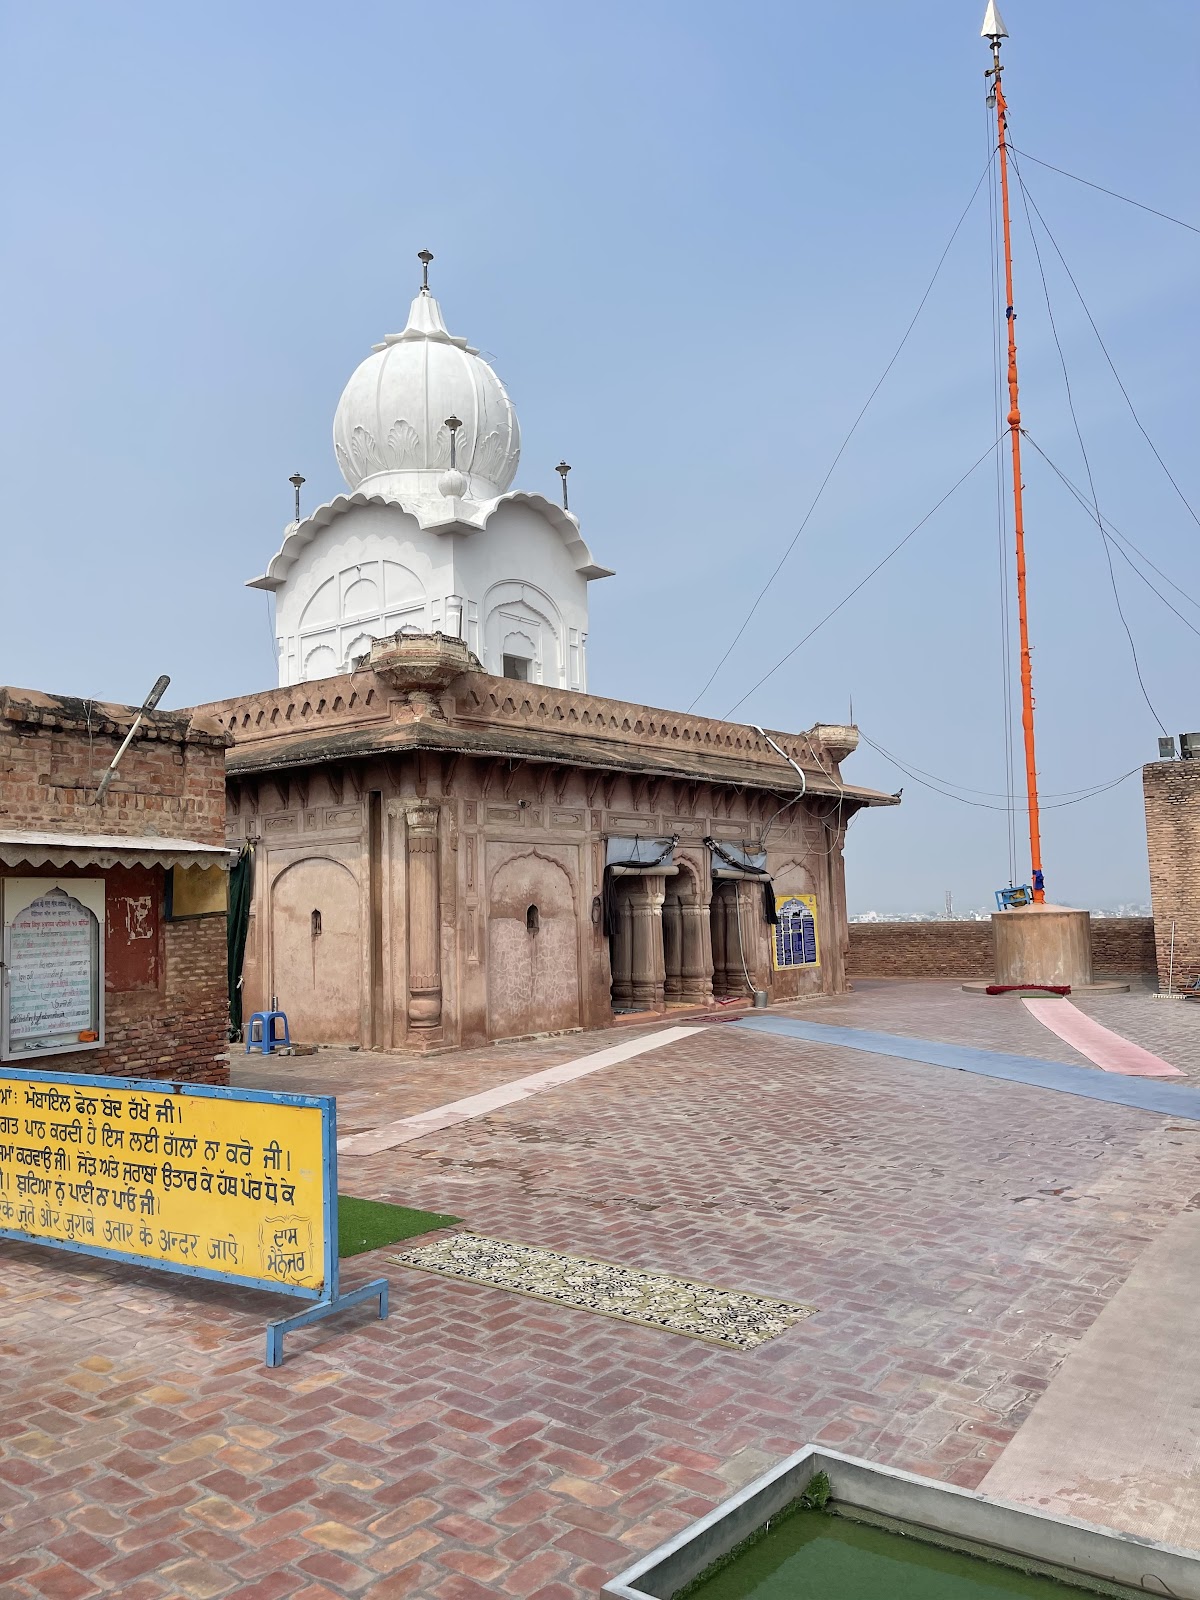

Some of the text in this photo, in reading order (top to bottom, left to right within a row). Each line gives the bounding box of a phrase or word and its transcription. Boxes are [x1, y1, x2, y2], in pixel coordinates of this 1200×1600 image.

[24, 1082, 71, 1112] ਮੋਬਾਇਲ
[73, 1088, 98, 1115] ਫੋਨ
[101, 1094, 122, 1118] ਬੰਦ
[128, 1095, 151, 1121] ਰੱਖੋ
[25, 1119, 46, 1139] ਪਾਠ
[50, 1119, 83, 1143] ਕਰਦੀ
[87, 1118, 97, 1145] ਹੈ
[102, 1122, 125, 1149] ਇਸ
[129, 1127, 159, 1153] ਲਈ
[163, 1130, 198, 1158] ਗੱਲਾਂ
[204, 1141, 220, 1161] ਨਾ
[226, 1135, 253, 1166] ਕਰੋ
[55, 1174, 66, 1206] ਨੂੰ
[68, 1180, 94, 1205] ਪਾਣੀ
[96, 1188, 109, 1206] ਨਾ
[112, 1187, 137, 1212] ਪਾਓ
[77, 1147, 97, 1177] ਜੋੜੇ
[99, 1155, 120, 1178] ਅਤੇ
[122, 1162, 157, 1186] ਜੁਰਾਬਾਂ
[161, 1162, 197, 1191] ਉਤਾਰ
[200, 1166, 214, 1193] ਕੇ
[216, 1169, 238, 1197] ਹੱਥ
[241, 1172, 262, 1200] ਪੈਰ
[264, 1172, 278, 1204] ਧੋ
[281, 1177, 295, 1205] ਕੇ
[38, 1200, 62, 1232] और
[63, 1208, 96, 1239] जुराबे
[103, 1219, 134, 1247] उतार
[139, 1218, 153, 1247] के
[158, 1229, 200, 1259] अन्दर
[273, 1228, 298, 1247] ਦਾਸ
